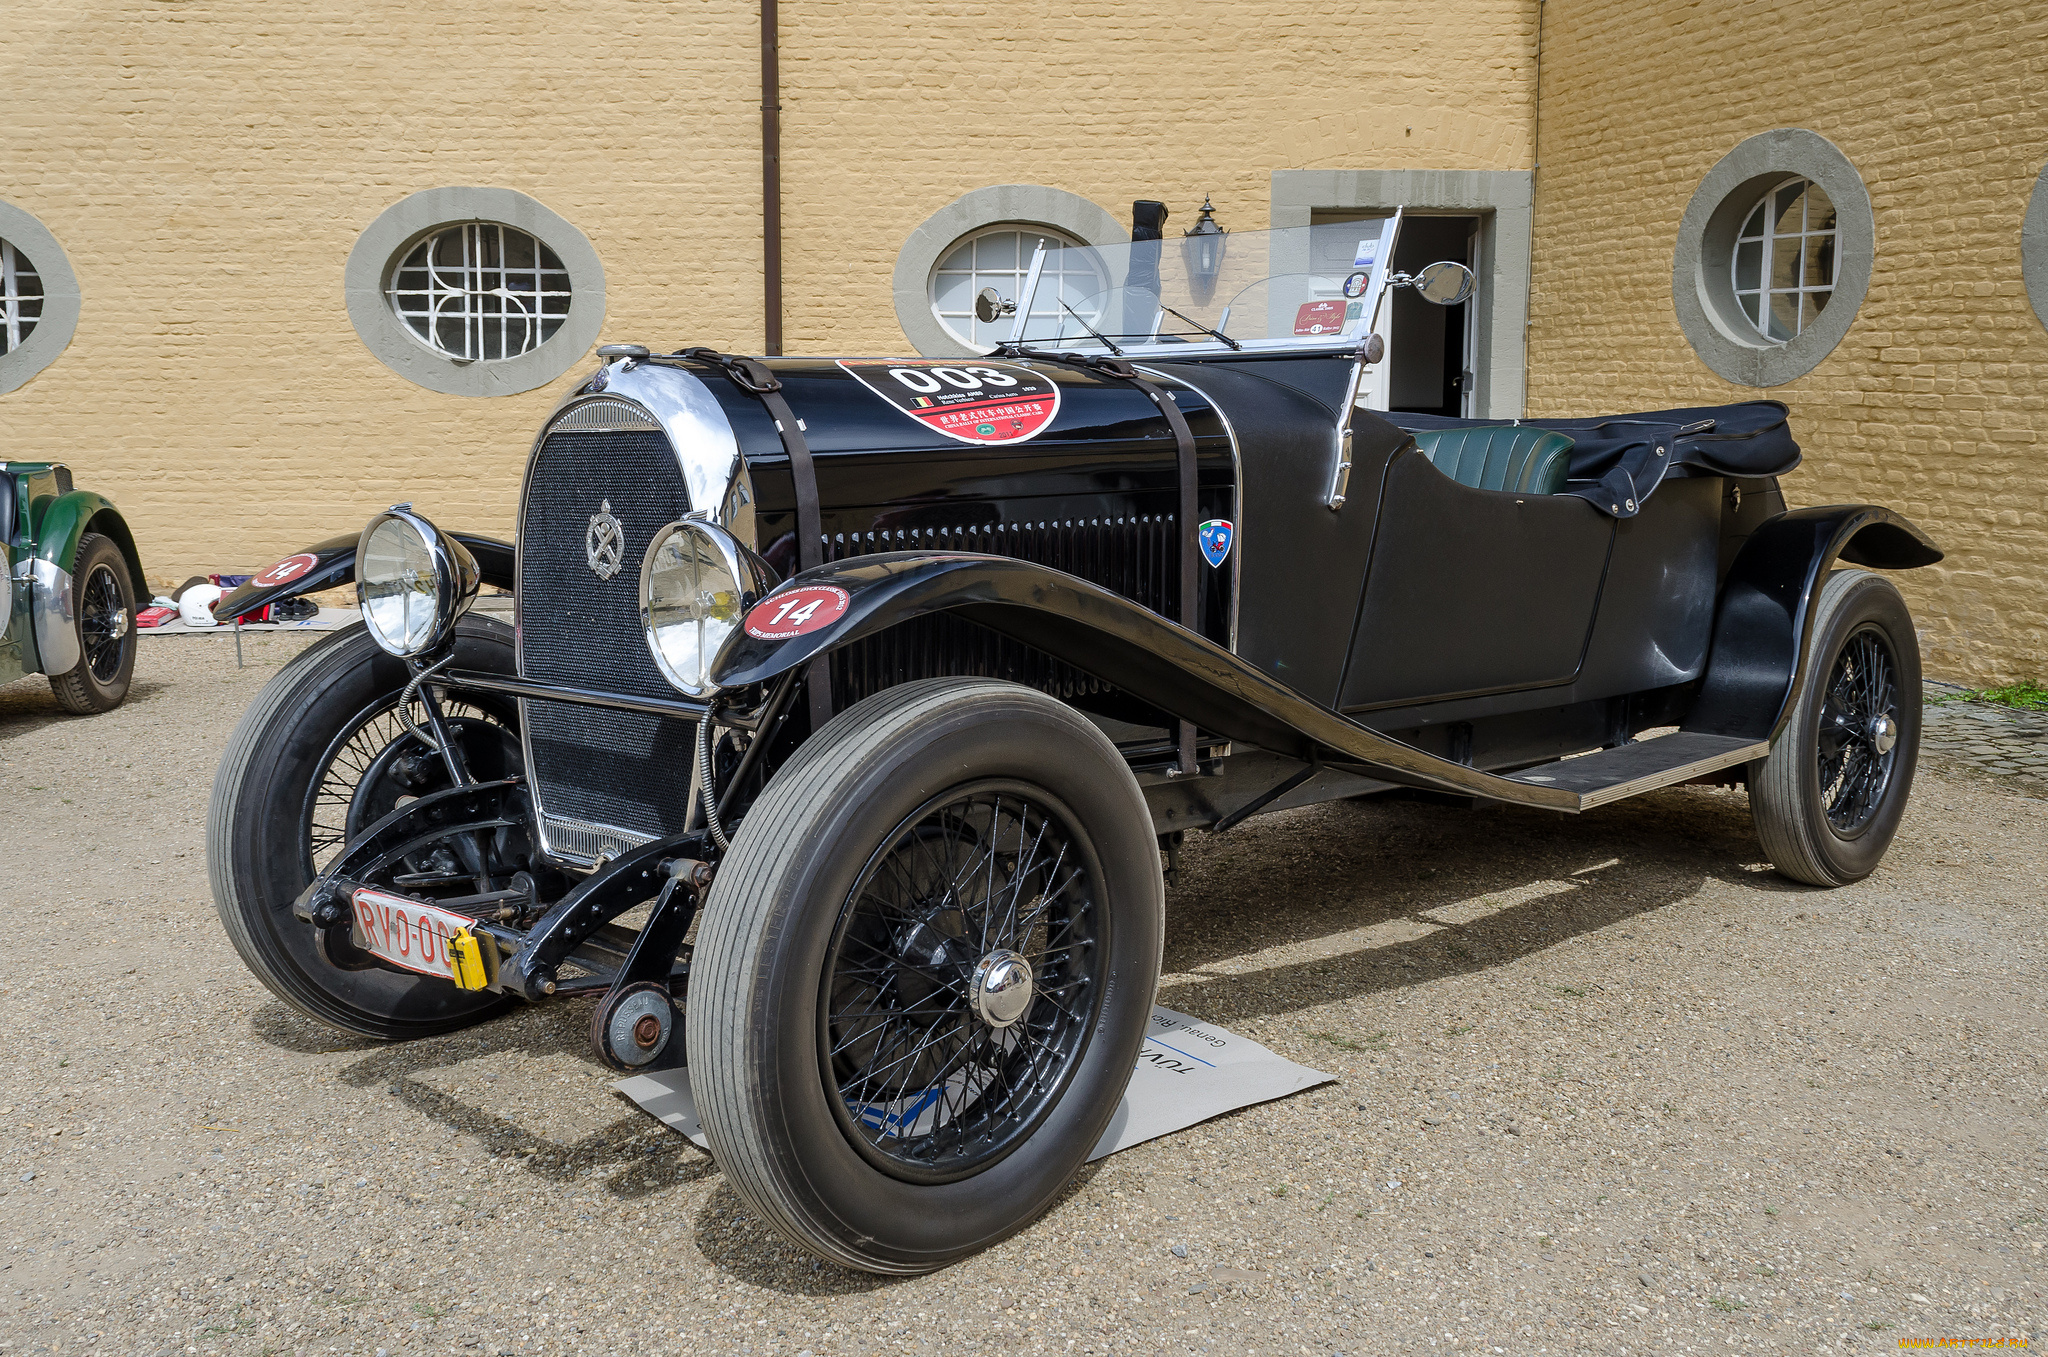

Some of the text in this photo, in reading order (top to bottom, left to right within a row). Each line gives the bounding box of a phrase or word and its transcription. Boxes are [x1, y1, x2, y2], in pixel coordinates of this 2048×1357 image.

[888, 367, 1018, 393] 003
[940, 403, 1042, 425] 世界老式汽车中国公开赛
[979, 415, 1013, 424] INTERNATIONAL
[265, 561, 303, 580] 14
[769, 599, 825, 626] 14
[760, 629, 800, 638] MEMORIAL
[358, 900, 458, 968] RVO-00
[1151, 1014, 1178, 1028] Ric
[1140, 1045, 1195, 1074] TÜV
